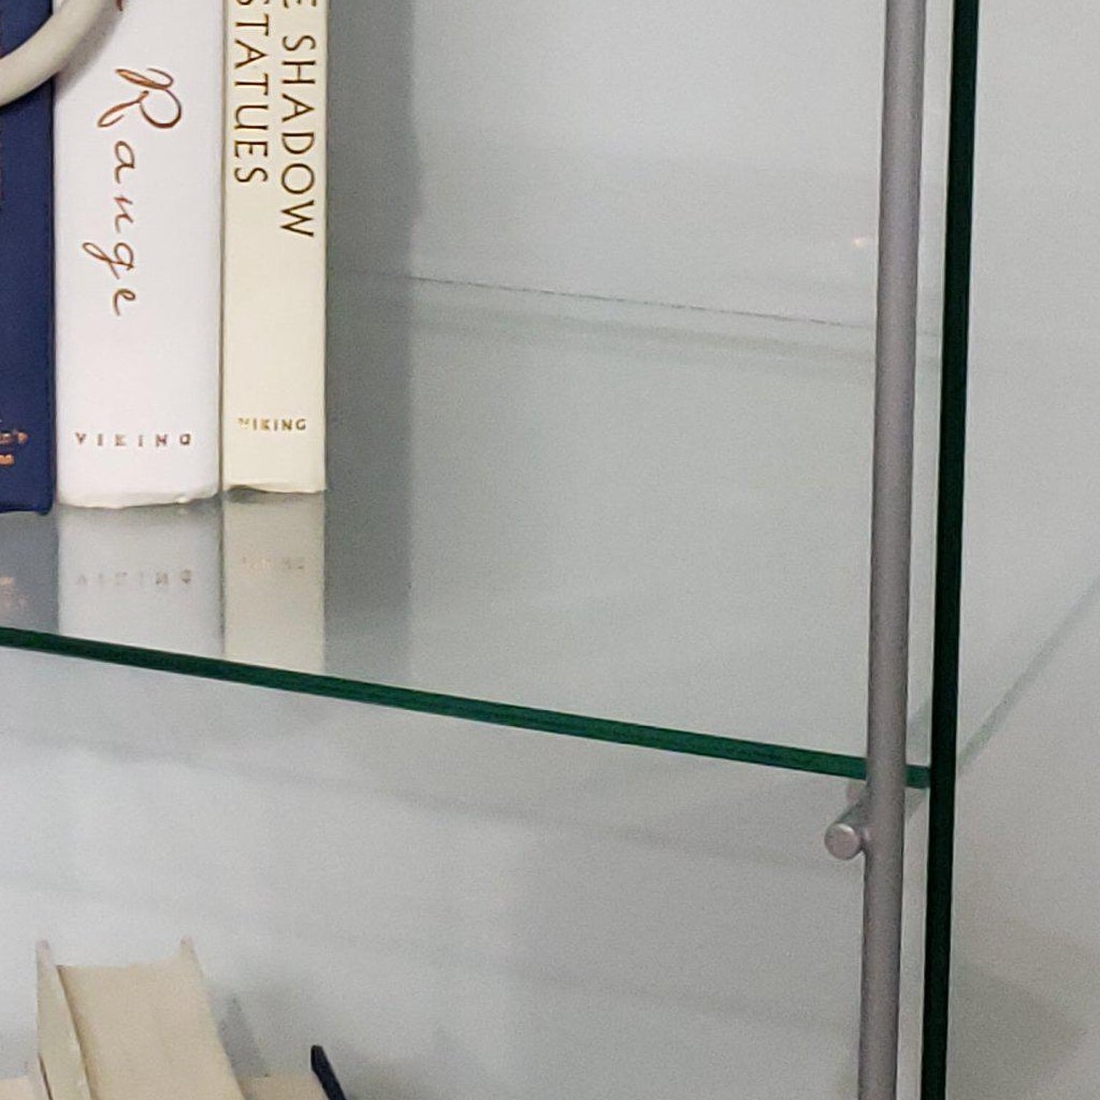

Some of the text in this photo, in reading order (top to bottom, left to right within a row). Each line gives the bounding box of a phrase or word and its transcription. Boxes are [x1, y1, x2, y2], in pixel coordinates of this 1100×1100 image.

[280, 35, 316, 238] SHADOW
[82, 67, 182, 316] Range
[75, 432, 192, 447] VIKING
[237, 417, 307, 432] VIKING
